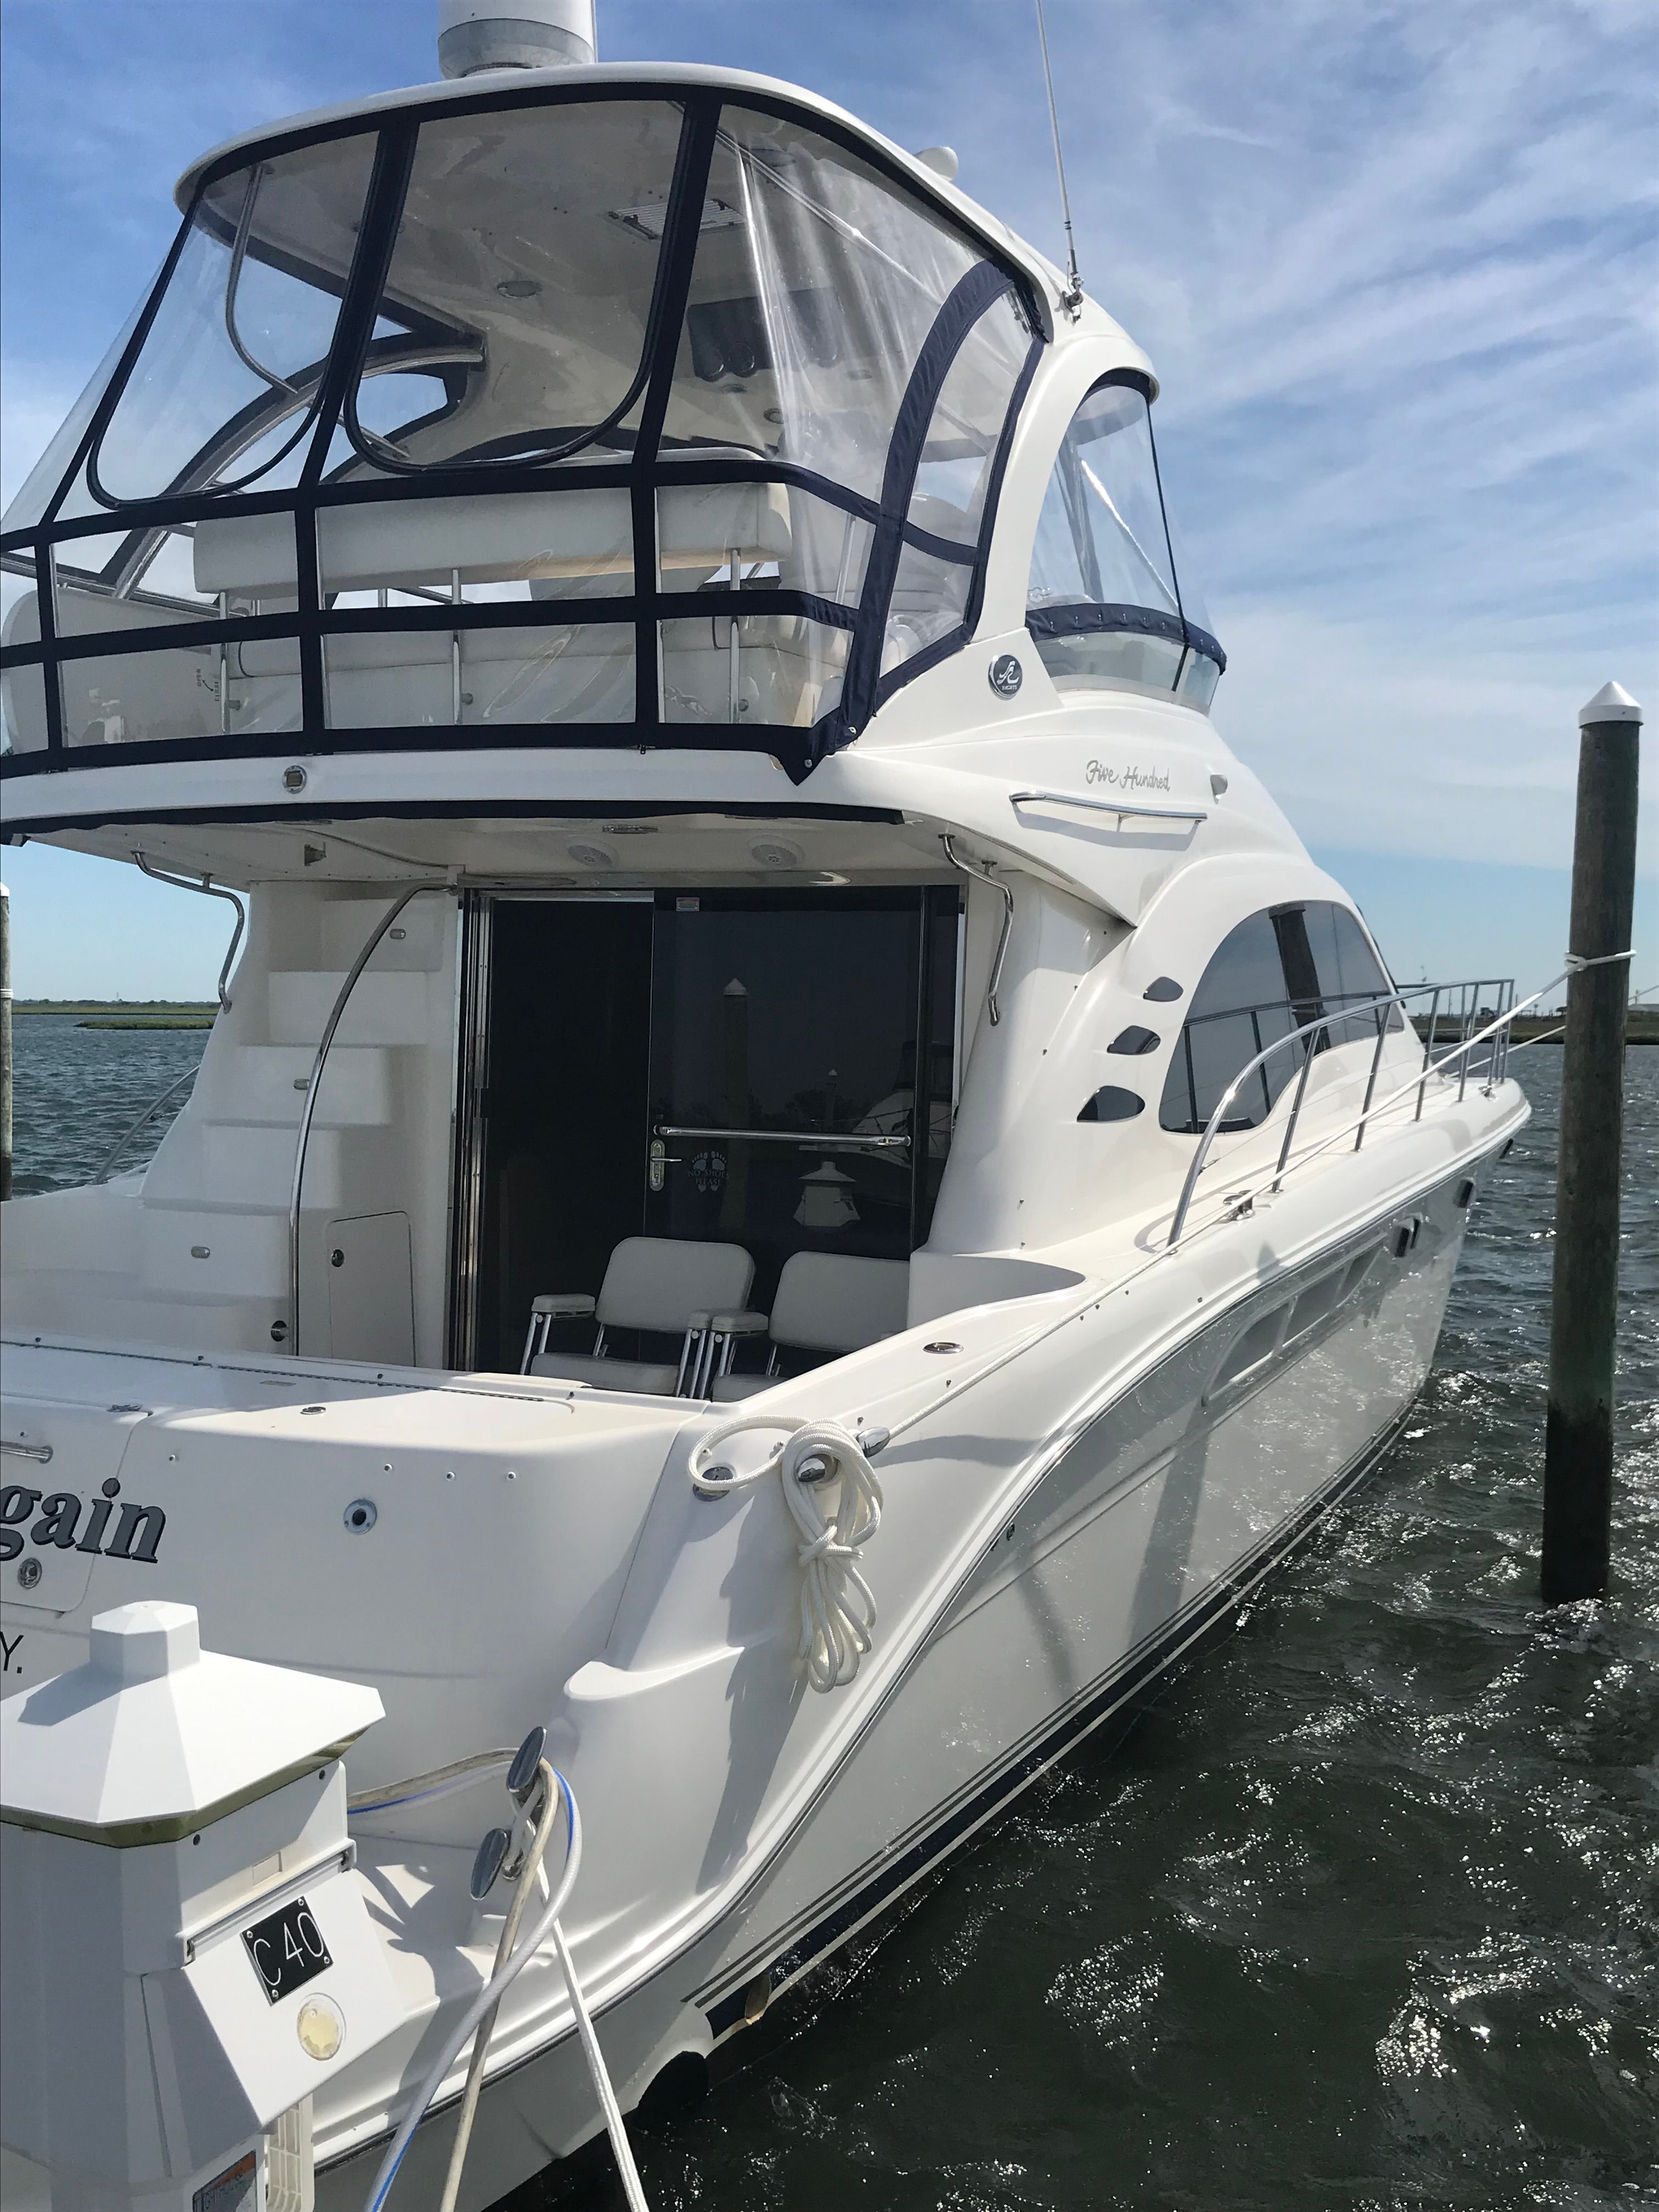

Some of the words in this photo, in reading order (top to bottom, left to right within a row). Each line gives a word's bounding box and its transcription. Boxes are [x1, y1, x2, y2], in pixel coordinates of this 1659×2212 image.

[1086, 759, 1119, 784] Five
[1120, 765, 1170, 792] Hundred
[688, 1169, 701, 1177] NO
[704, 1169, 729, 1180] SHOES
[253, 1938, 281, 1986] C
[283, 1911, 324, 1967] 40
